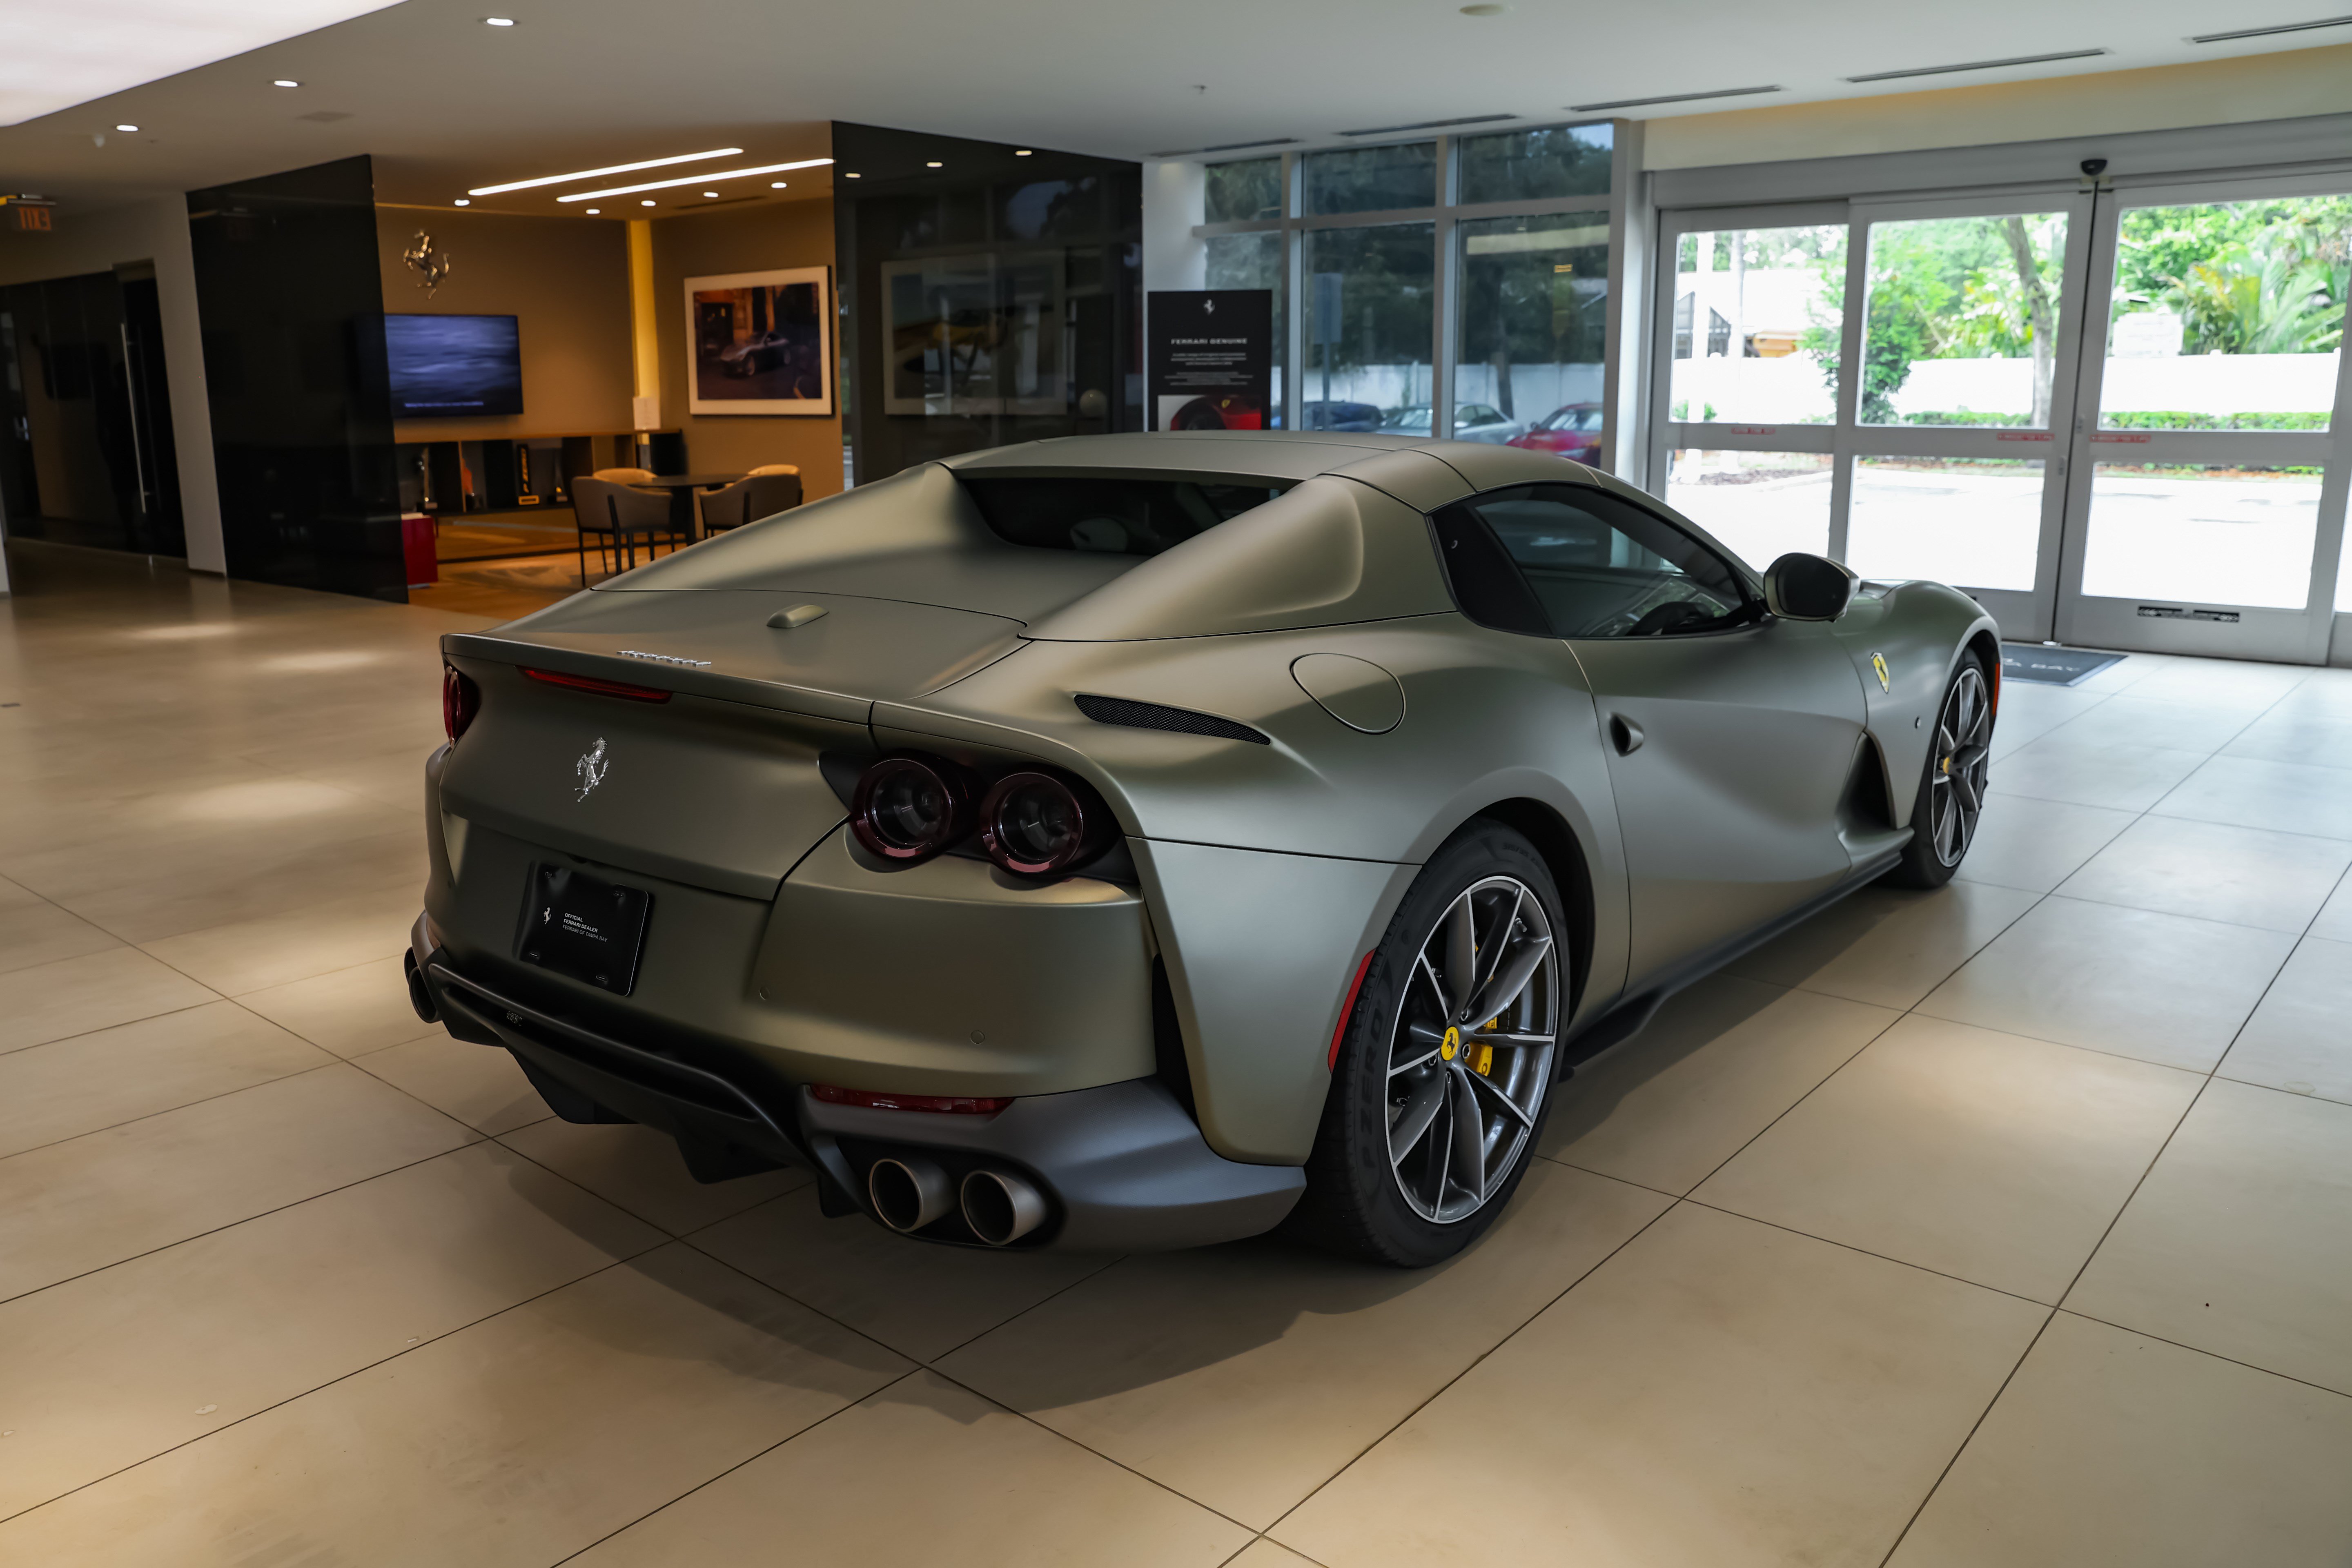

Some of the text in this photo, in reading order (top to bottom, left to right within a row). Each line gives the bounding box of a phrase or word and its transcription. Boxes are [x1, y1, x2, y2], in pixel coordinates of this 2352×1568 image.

[565, 913, 583, 922] OFFICIAL
[563, 924, 579, 933] FERRARI
[586, 931, 599, 940] TAMPA
[564, 919, 598, 933] FERRARI DEALER
[1361, 1008, 1383, 1136] ZERO
